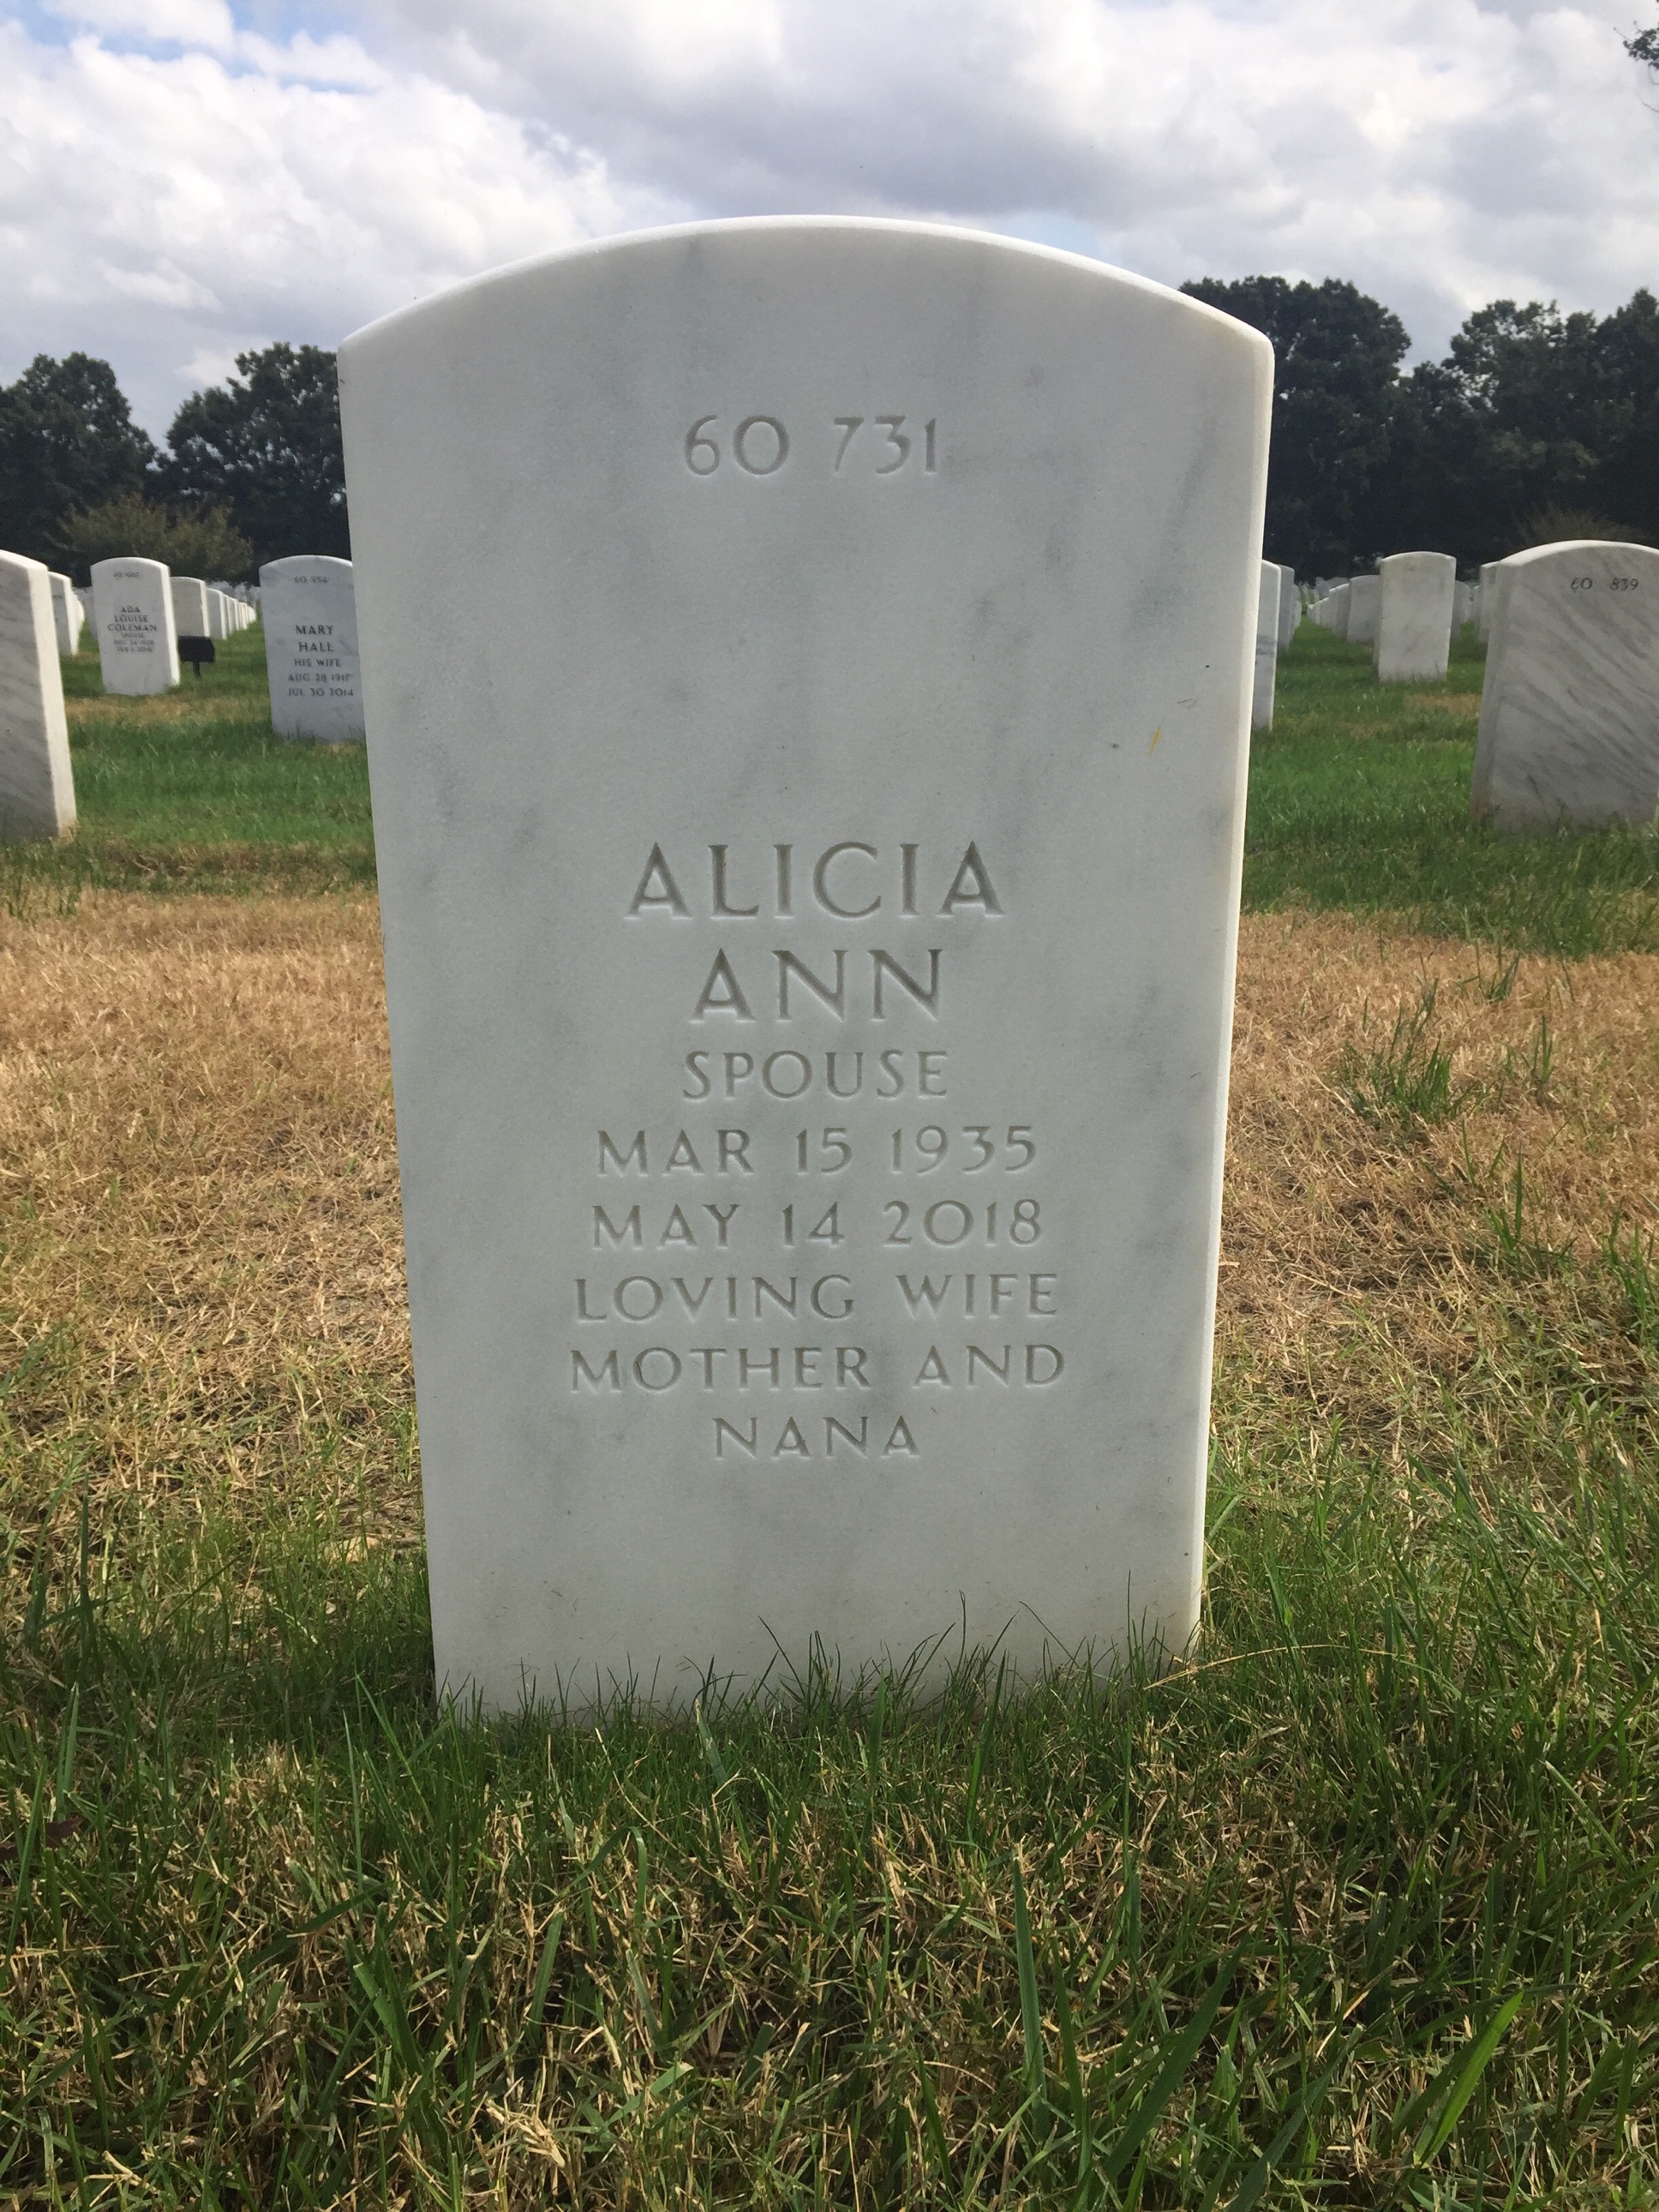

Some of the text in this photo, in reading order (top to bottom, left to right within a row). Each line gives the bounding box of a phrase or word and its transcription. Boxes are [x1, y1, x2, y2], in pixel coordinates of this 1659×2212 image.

[685, 415, 937, 476] 60 731
[1570, 577, 1639, 590] 60 839
[114, 614, 148, 623] LOUISE
[121, 605, 141, 614] ADA
[107, 623, 158, 632] COLEMAN
[296, 624, 333, 635] MARY
[298, 641, 334, 652] HALL
[288, 673, 310, 682] AUG
[294, 658, 341, 668] HIS WIFE
[288, 687, 354, 697] JUL 30 2014
[624, 841, 1005, 920] ALICIA
[688, 948, 943, 1022] ANN
[683, 1050, 949, 1101] SPOUSE
[597, 1125, 1037, 1178] MAR 15 1935
[592, 1199, 1041, 1250] MAY 14 2018
[575, 1273, 1058, 1323] LOVING WIFE
[570, 1343, 1065, 1395] MOTHER AND
[712, 1415, 921, 1461] NANA
